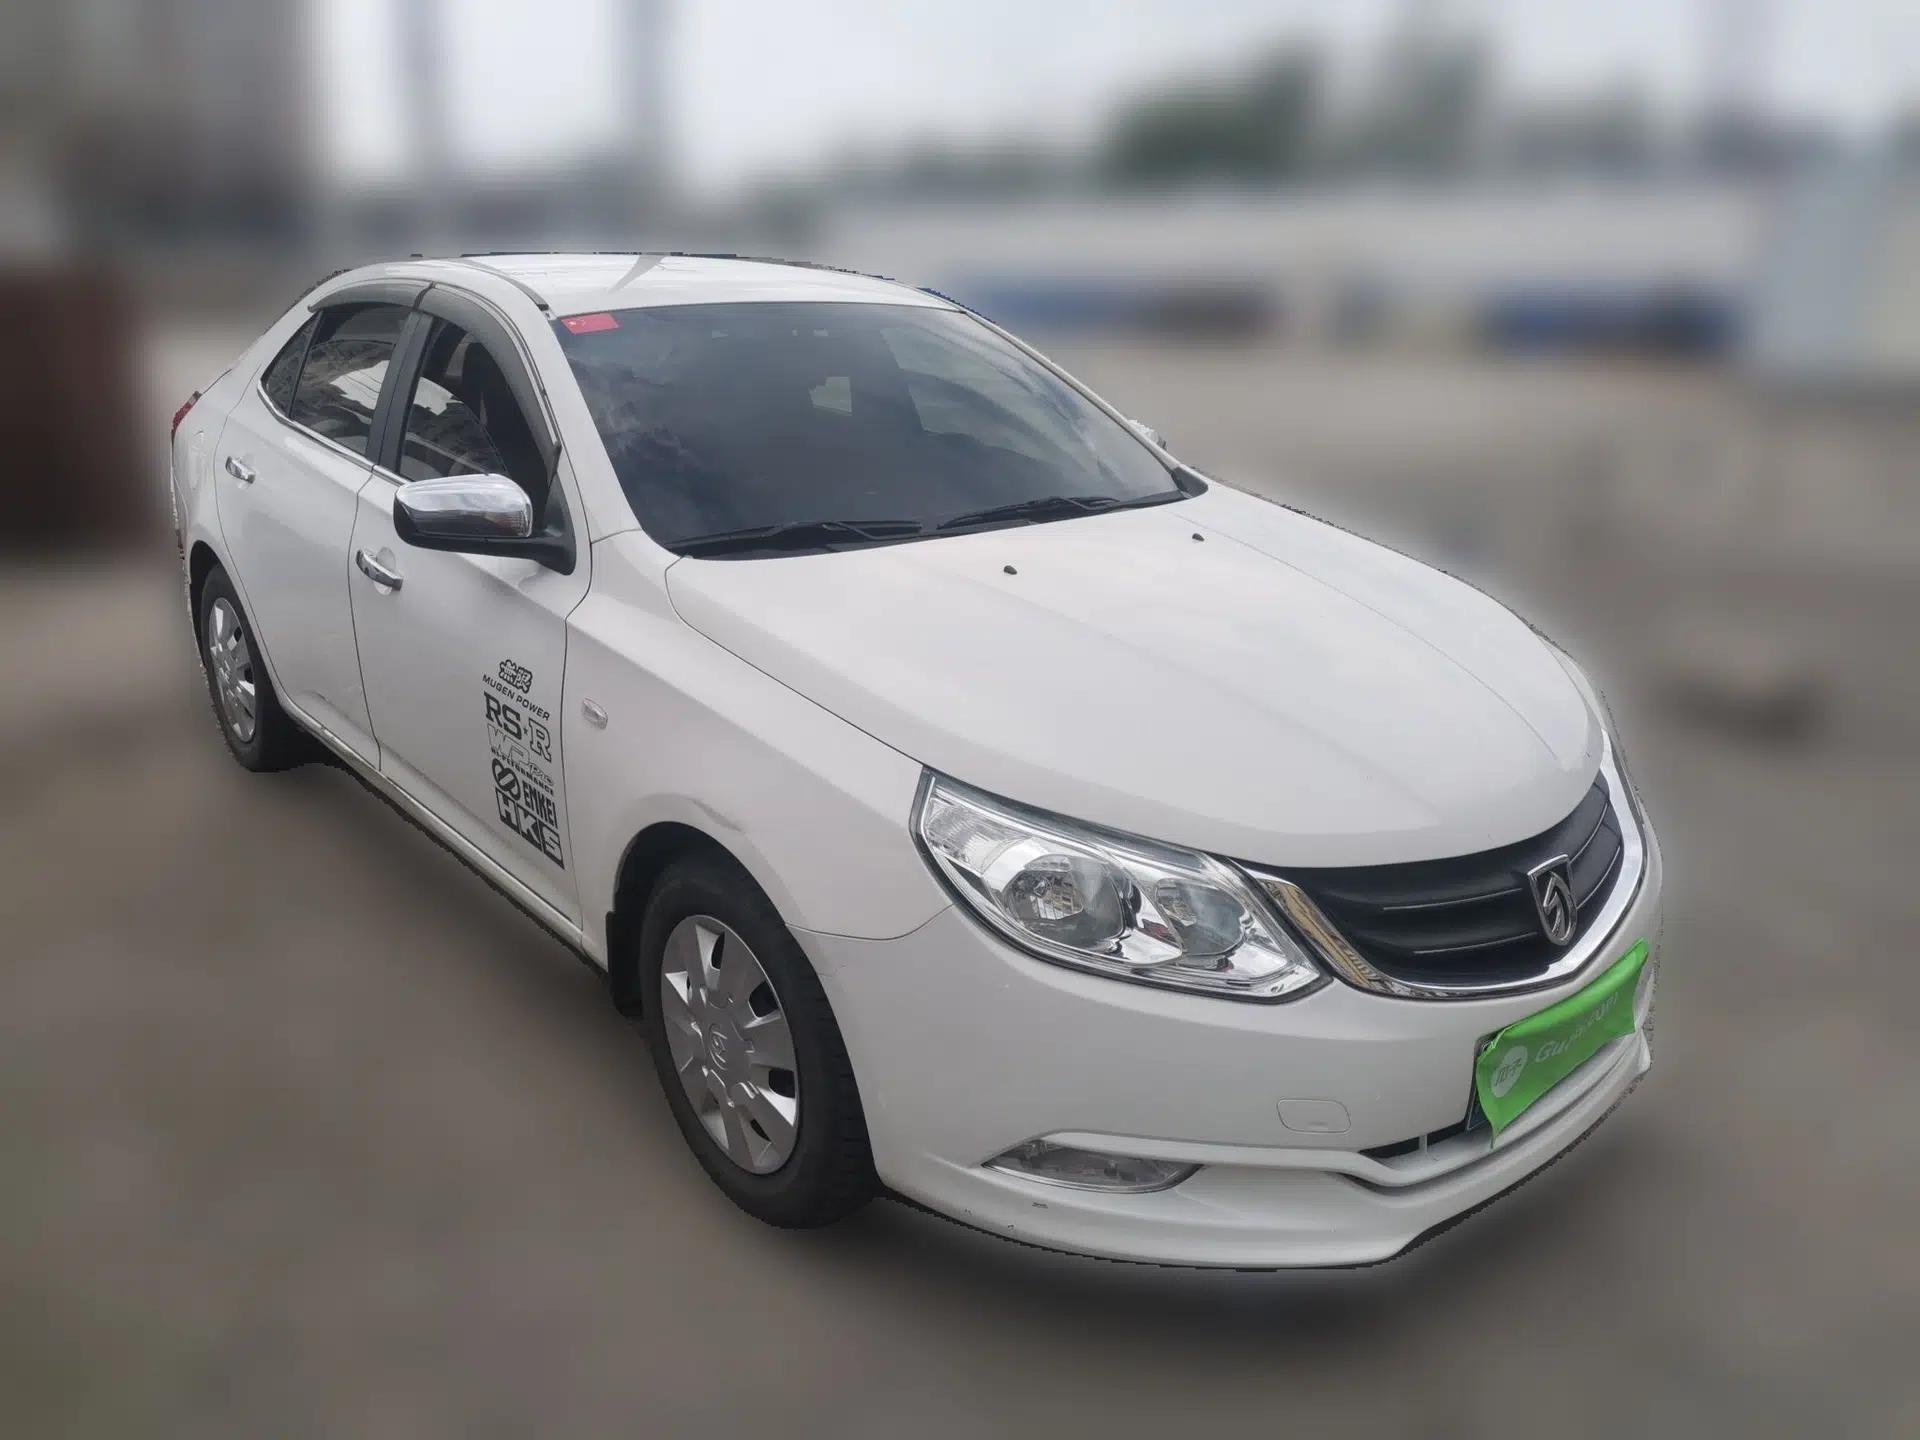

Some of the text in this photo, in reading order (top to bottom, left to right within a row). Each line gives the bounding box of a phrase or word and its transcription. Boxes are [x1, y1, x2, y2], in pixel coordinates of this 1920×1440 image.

[482, 674, 550, 721] MUGEN POWER
[495, 786, 565, 870] HKS
[522, 781, 558, 830] ENKEI
